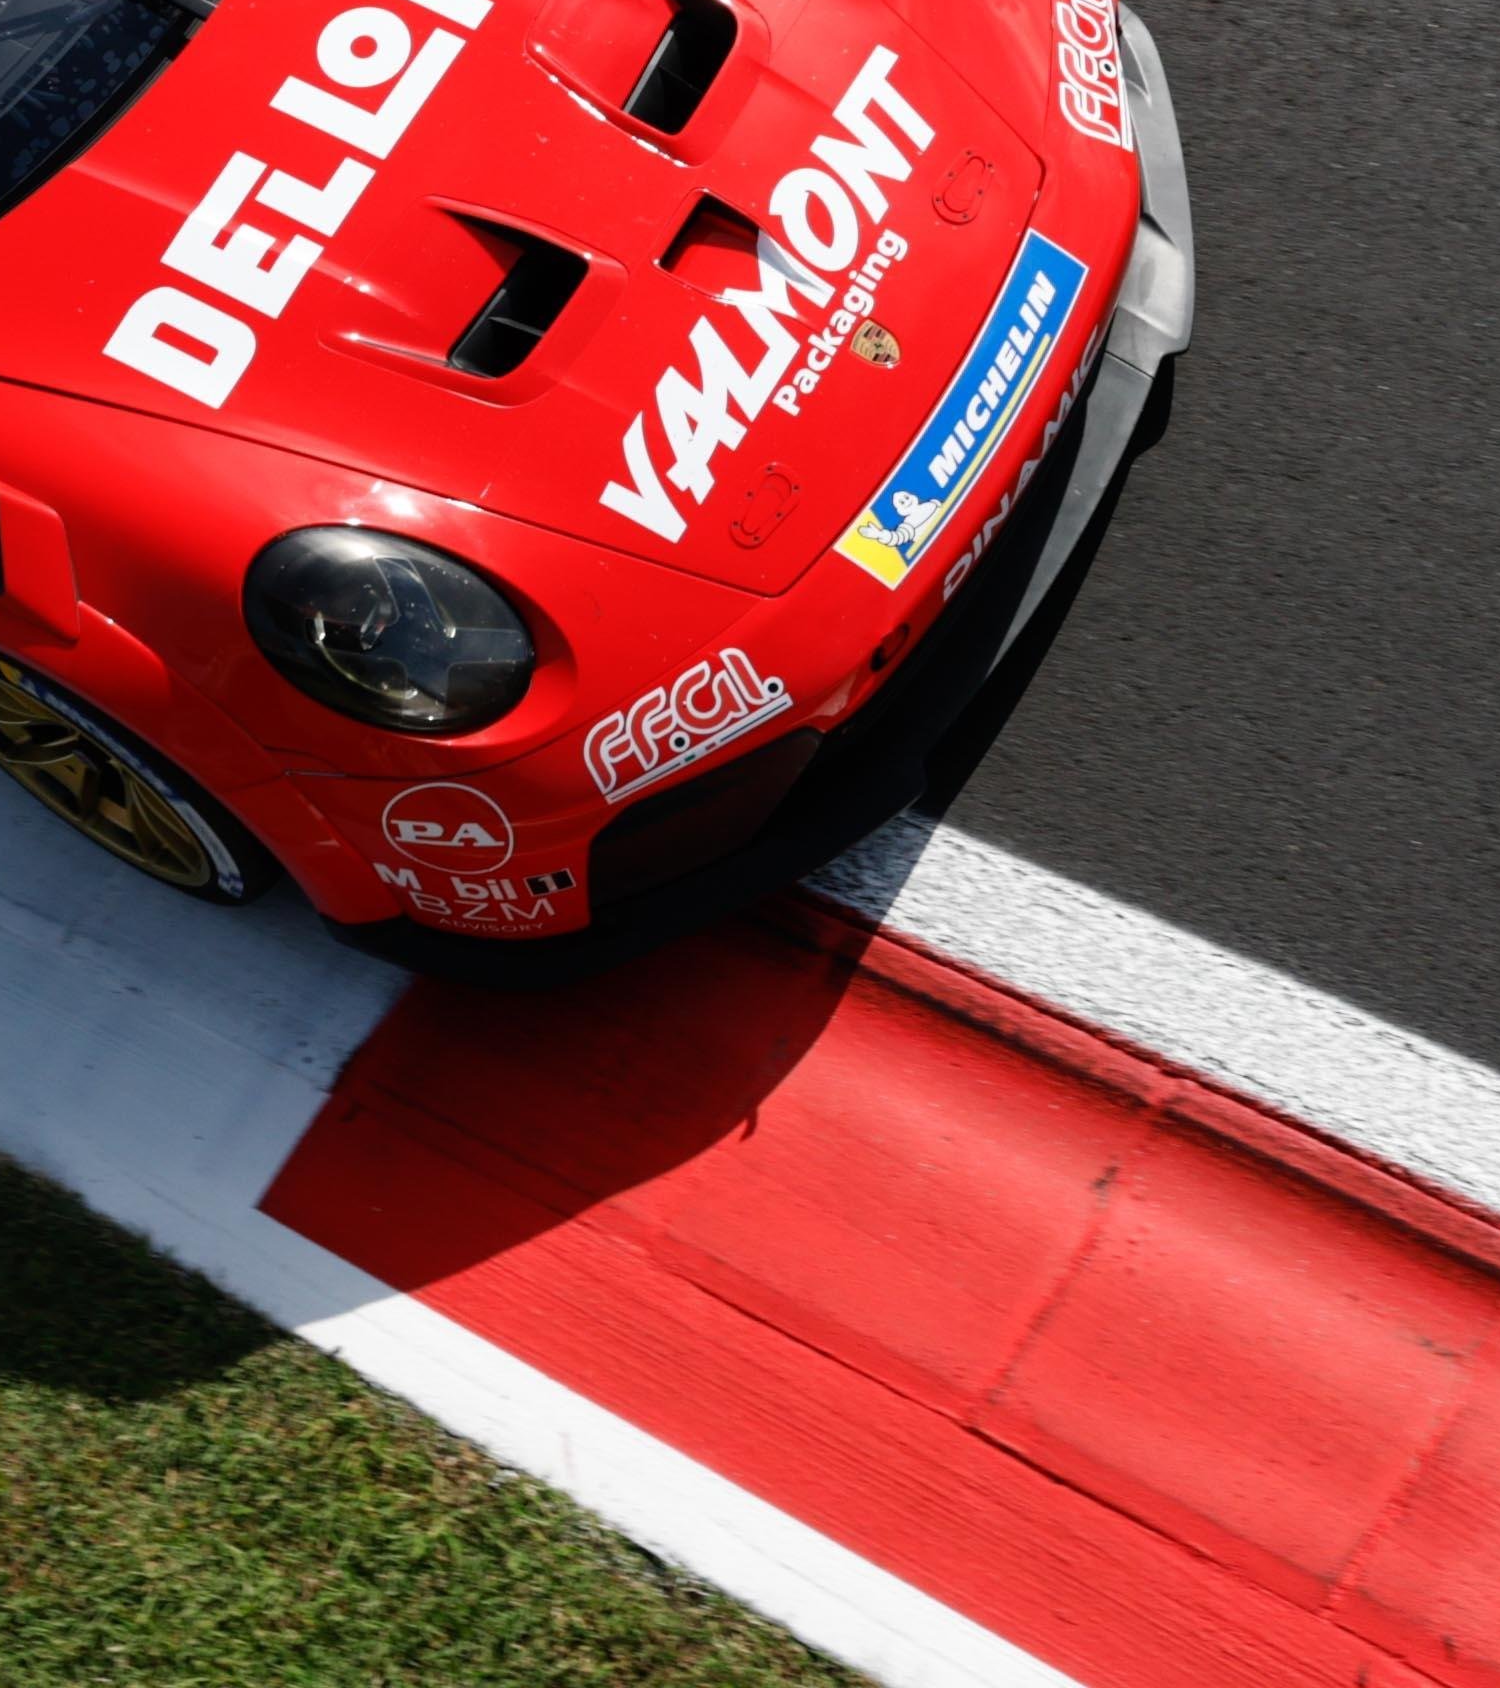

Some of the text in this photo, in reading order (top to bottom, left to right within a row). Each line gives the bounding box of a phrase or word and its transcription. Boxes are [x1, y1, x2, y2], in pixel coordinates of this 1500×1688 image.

[598, 43, 936, 545] VALMONT
[772, 228, 908, 416] Packaging
[927, 269, 1057, 489] MICHELIN
[373, 862, 519, 901] Mbil
[390, 819, 505, 847] PA
[408, 891, 556, 922] BZM
